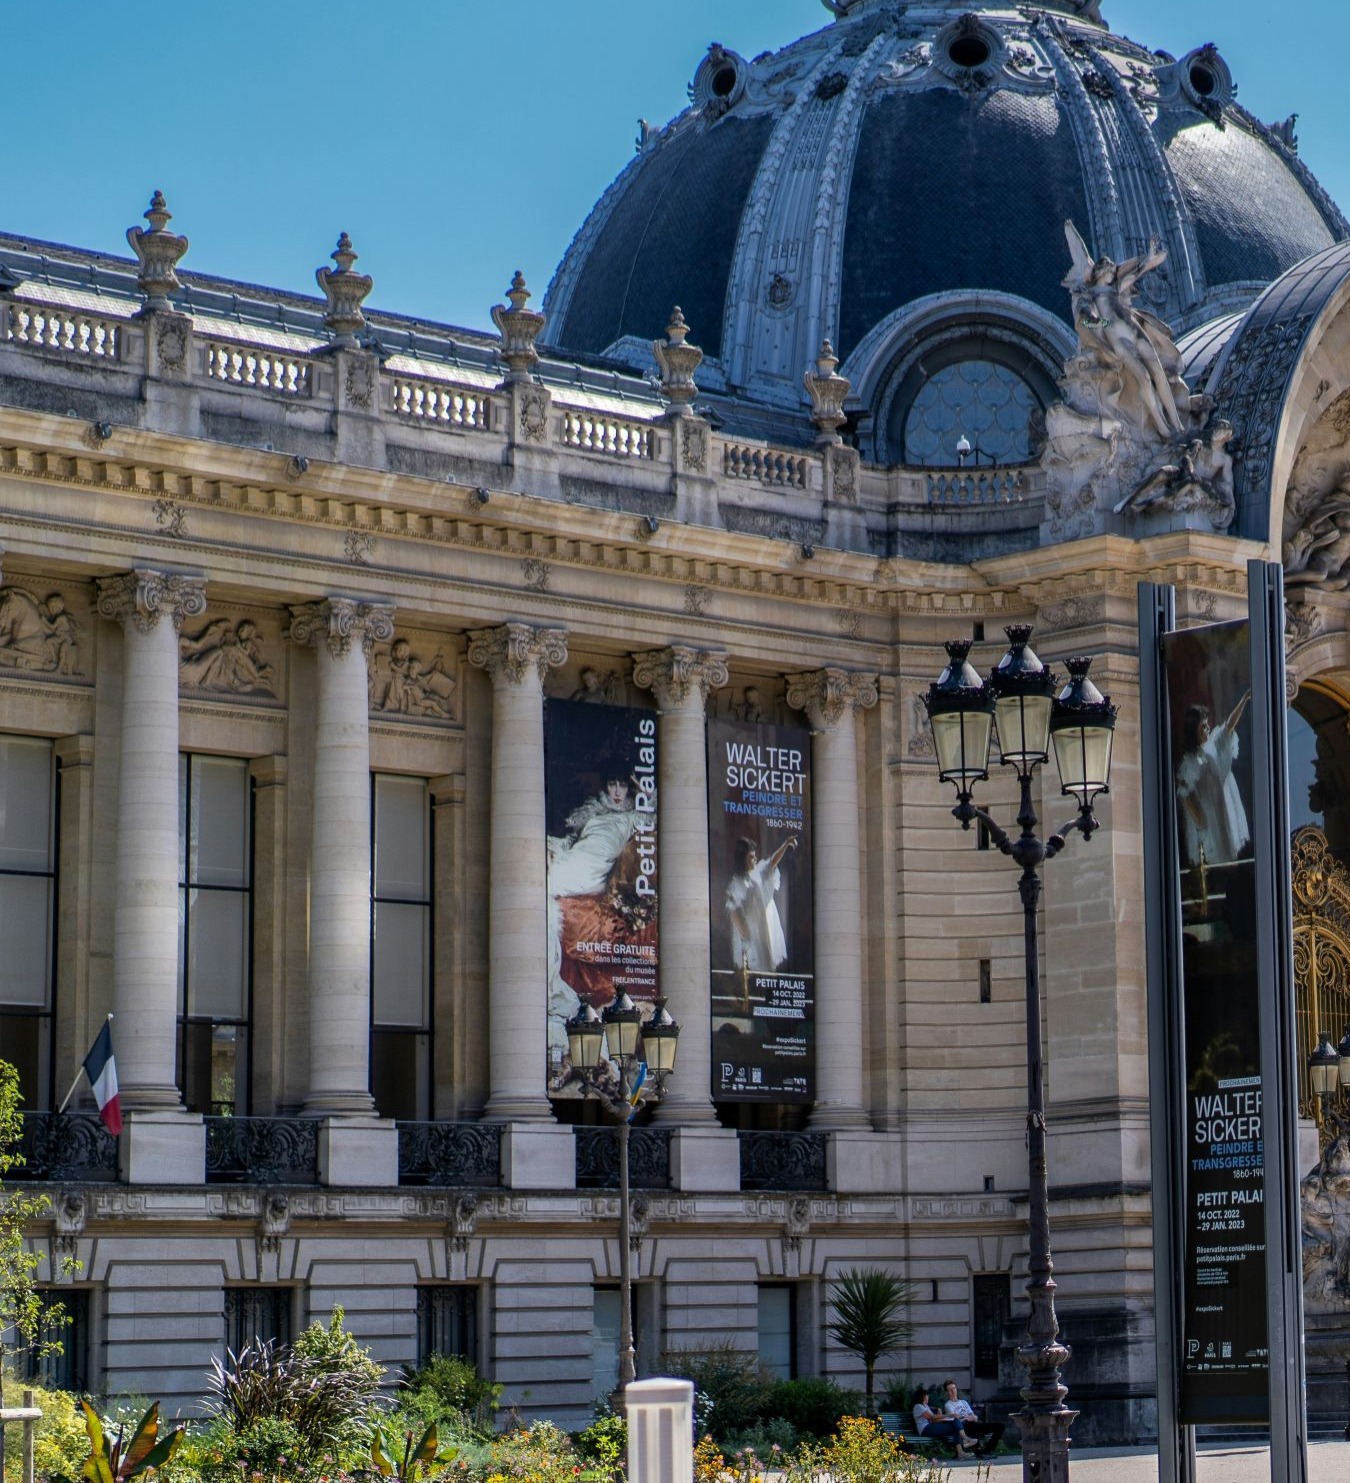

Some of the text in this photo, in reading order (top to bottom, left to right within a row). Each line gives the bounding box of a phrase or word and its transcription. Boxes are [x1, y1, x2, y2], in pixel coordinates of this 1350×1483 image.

[726, 742, 802, 771] WALTER
[726, 766, 807, 794] SICKERT
[742, 790, 803, 807] PEINDRE ET
[634, 719, 656, 897] Petit Palais
[723, 801, 803, 820] TRANSGRESSER
[766, 818, 803, 830] 1860-1942
[576, 940, 656, 956] ENTRÉE GRATUITE
[594, 955, 656, 966] dans les collections
[625, 966, 656, 975] du musée
[626, 977, 656, 985] ENTRANCE
[756, 978, 806, 990] PETIT PALAIS
[754, 1007, 805, 1017] ROCHAINEMEN
[1220, 1077, 1261, 1088] PROCHAINEMEN
[1195, 1117, 1261, 1143] SICKER
[1210, 1141, 1254, 1156] PEINDRE
[1192, 1155, 1263, 1171] TRANSGRESSE
[1232, 1168, 1264, 1179] 1860-194
[1197, 1189, 1263, 1207] PETIT PALAI
[1198, 1210, 1240, 1220] 14 OCT. 2022
[1211, 1221, 1227, 1230] JAN.
[1228, 1220, 1245, 1229] 2023
[1196, 1245, 1228, 1254] Réservation
[1196, 1253, 1246, 1264] petitpalais.paris.fr
